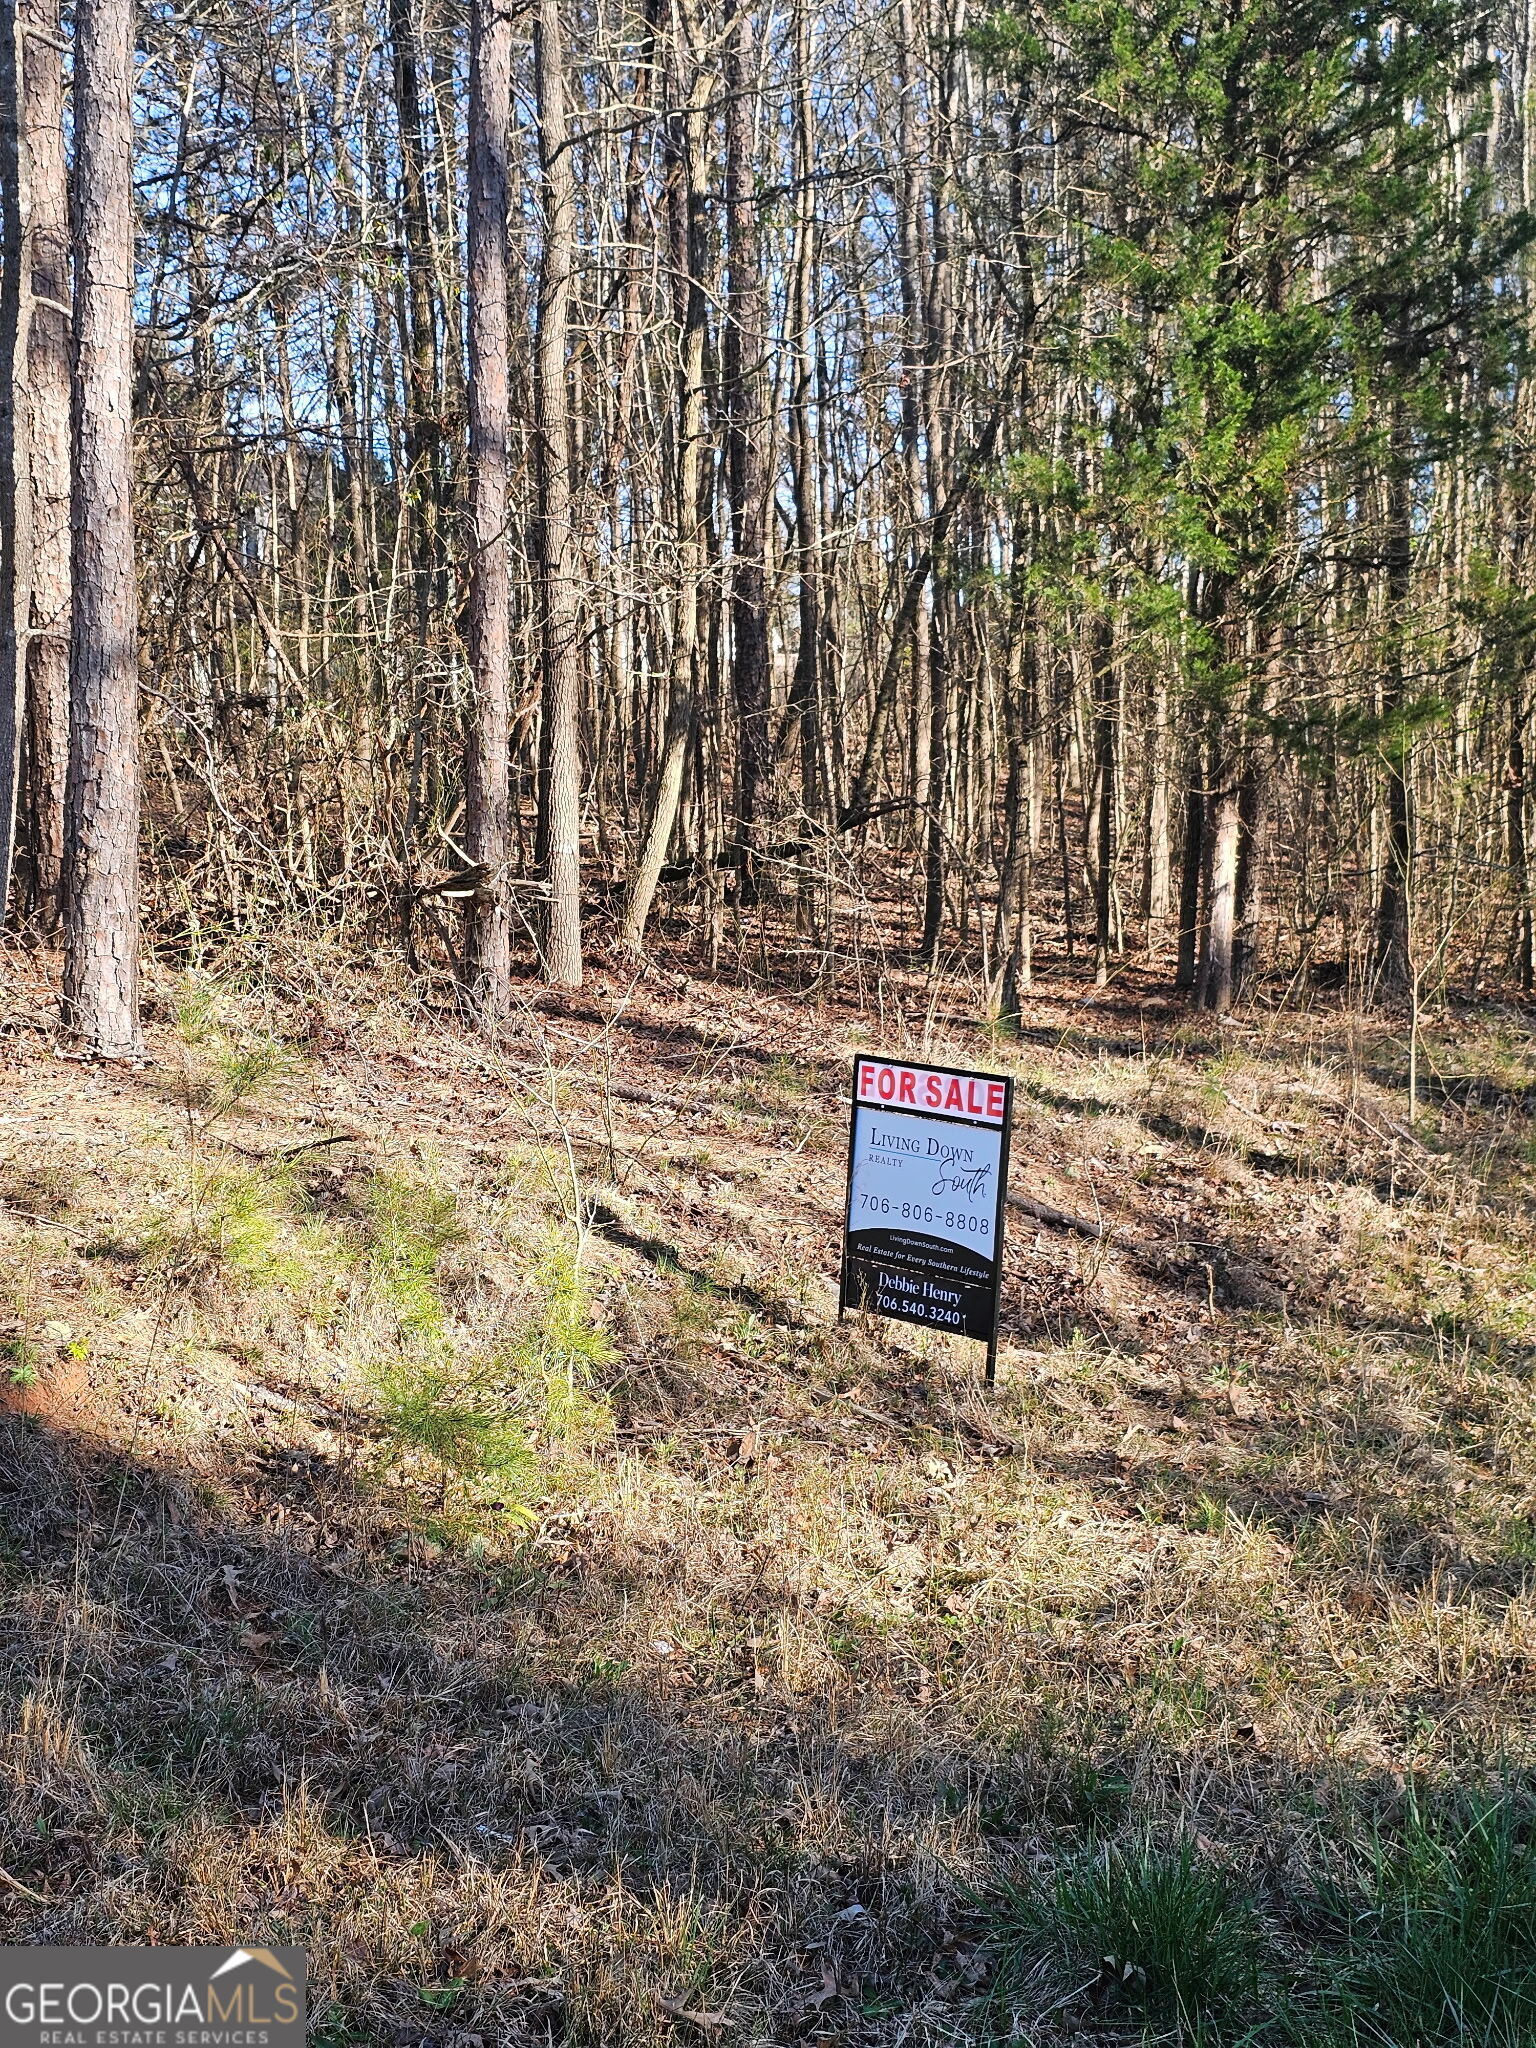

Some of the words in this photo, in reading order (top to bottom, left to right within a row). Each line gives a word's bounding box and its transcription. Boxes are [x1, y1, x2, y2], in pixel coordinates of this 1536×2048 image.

[860, 1065, 917, 1104] FOR
[925, 1075, 1004, 1118] SALE
[868, 1153, 903, 1168] REALTY
[931, 1157, 992, 1203] South
[860, 1193, 989, 1235] 706-806-8808
[856, 1243, 872, 1252] Real
[873, 1246, 893, 1258] Estate
[894, 1250, 906, 1260] for
[906, 1254, 926, 1266] Every
[927, 1258, 958, 1272] Southern
[959, 1265, 990, 1279] Lifestyle
[889, 1234, 954, 1254] LivingDownSouth.com
[878, 1271, 920, 1295] Debbie
[922, 1281, 962, 1307] Henry
[876, 1294, 960, 1325] 706.540.3240
